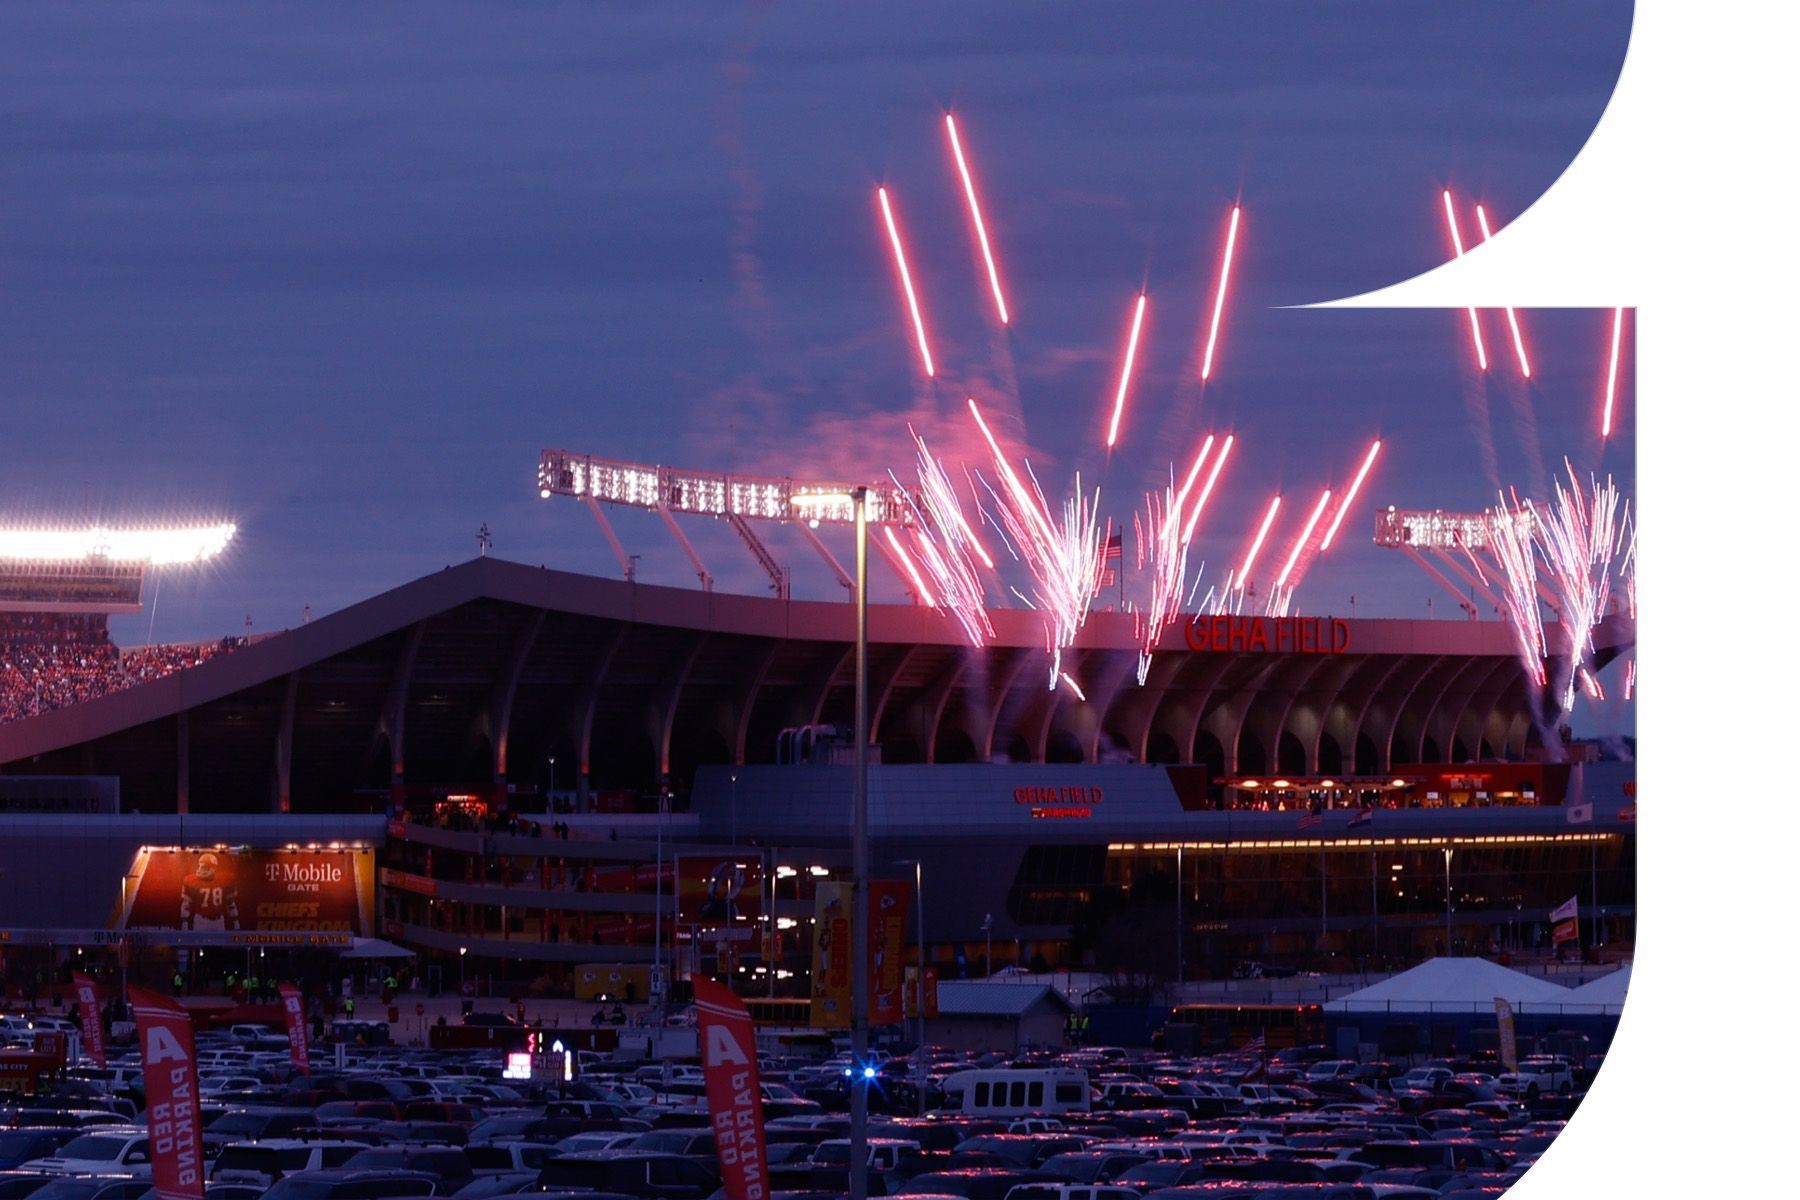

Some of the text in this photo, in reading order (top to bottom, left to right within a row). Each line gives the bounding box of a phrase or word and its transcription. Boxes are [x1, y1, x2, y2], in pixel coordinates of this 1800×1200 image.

[1184, 615, 1351, 654] GEHA FIELD
[1013, 786, 1103, 804] GEHA FIELD
[283, 863, 342, 882] Mobile
[287, 883, 320, 892] GATE
[199, 887, 223, 908] 78
[256, 901, 320, 918] CHIEFS
